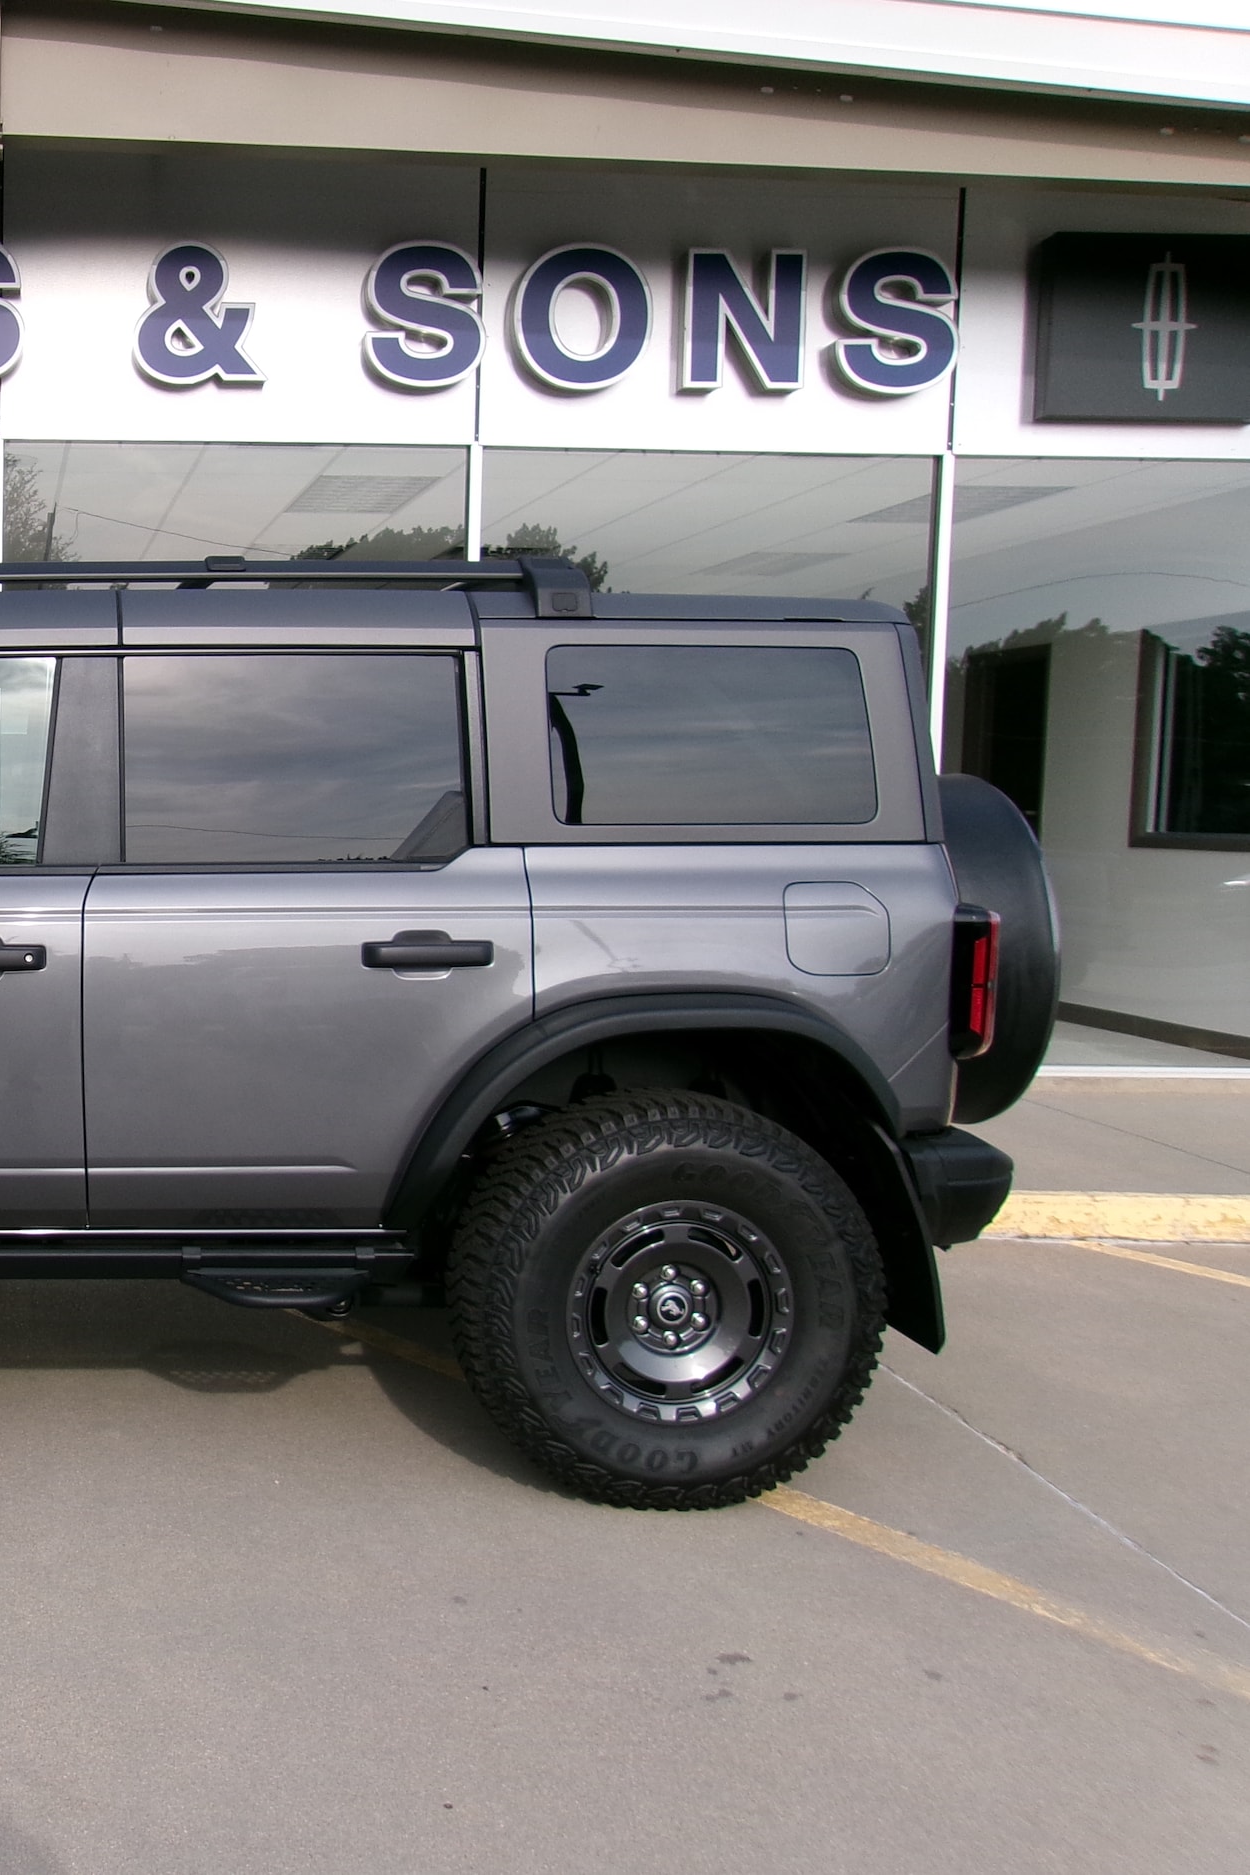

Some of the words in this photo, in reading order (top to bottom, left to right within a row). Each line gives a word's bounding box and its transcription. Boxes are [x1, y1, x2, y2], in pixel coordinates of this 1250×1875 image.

[133, 241, 267, 386] &
[362, 240, 960, 396] SONS
[525, 1306, 699, 1472] GOODYEAR
